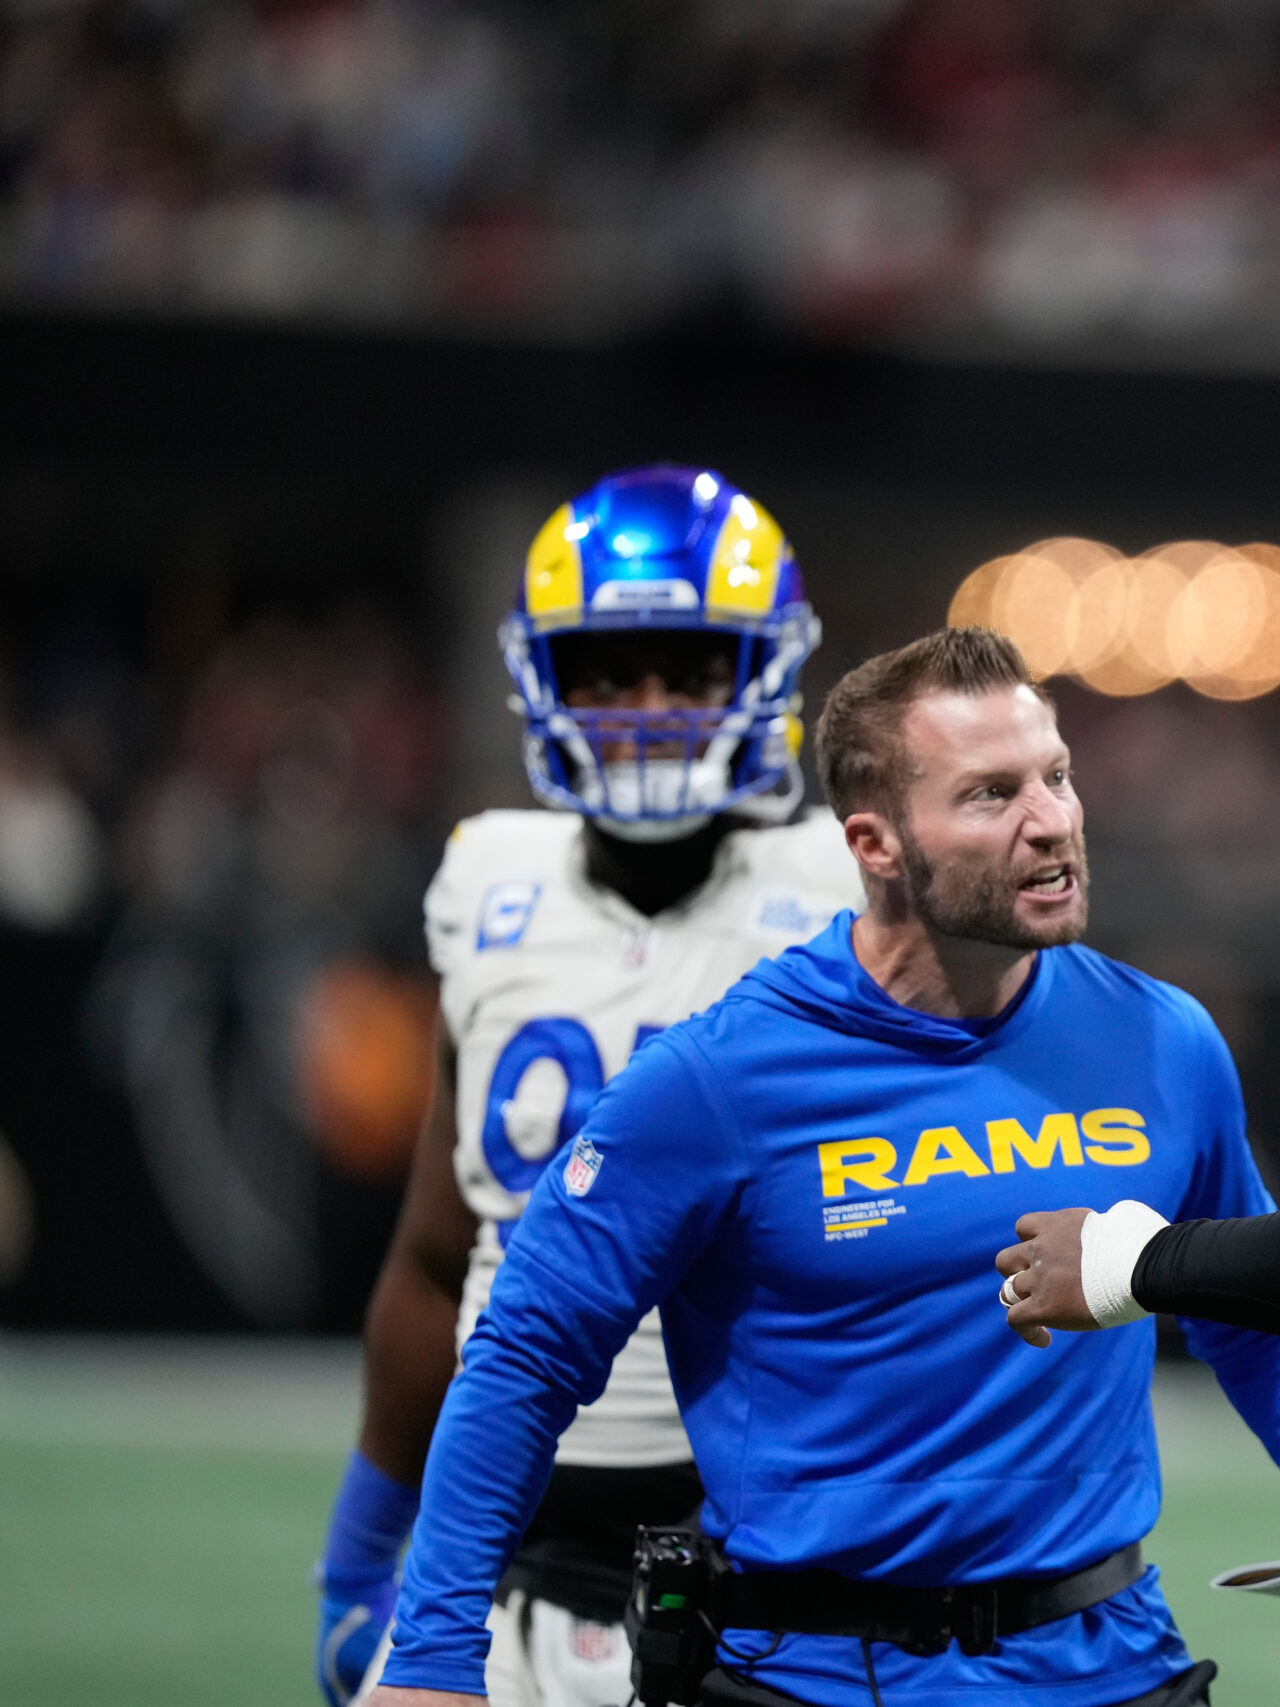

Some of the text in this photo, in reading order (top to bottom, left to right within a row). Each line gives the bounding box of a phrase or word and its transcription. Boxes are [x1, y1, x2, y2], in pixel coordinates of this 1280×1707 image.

[817, 1107, 1151, 1197] RAMS
[822, 1198, 895, 1215] ENGINEERED FOR
[823, 1205, 907, 1225] LOS ANGELES RAMS
